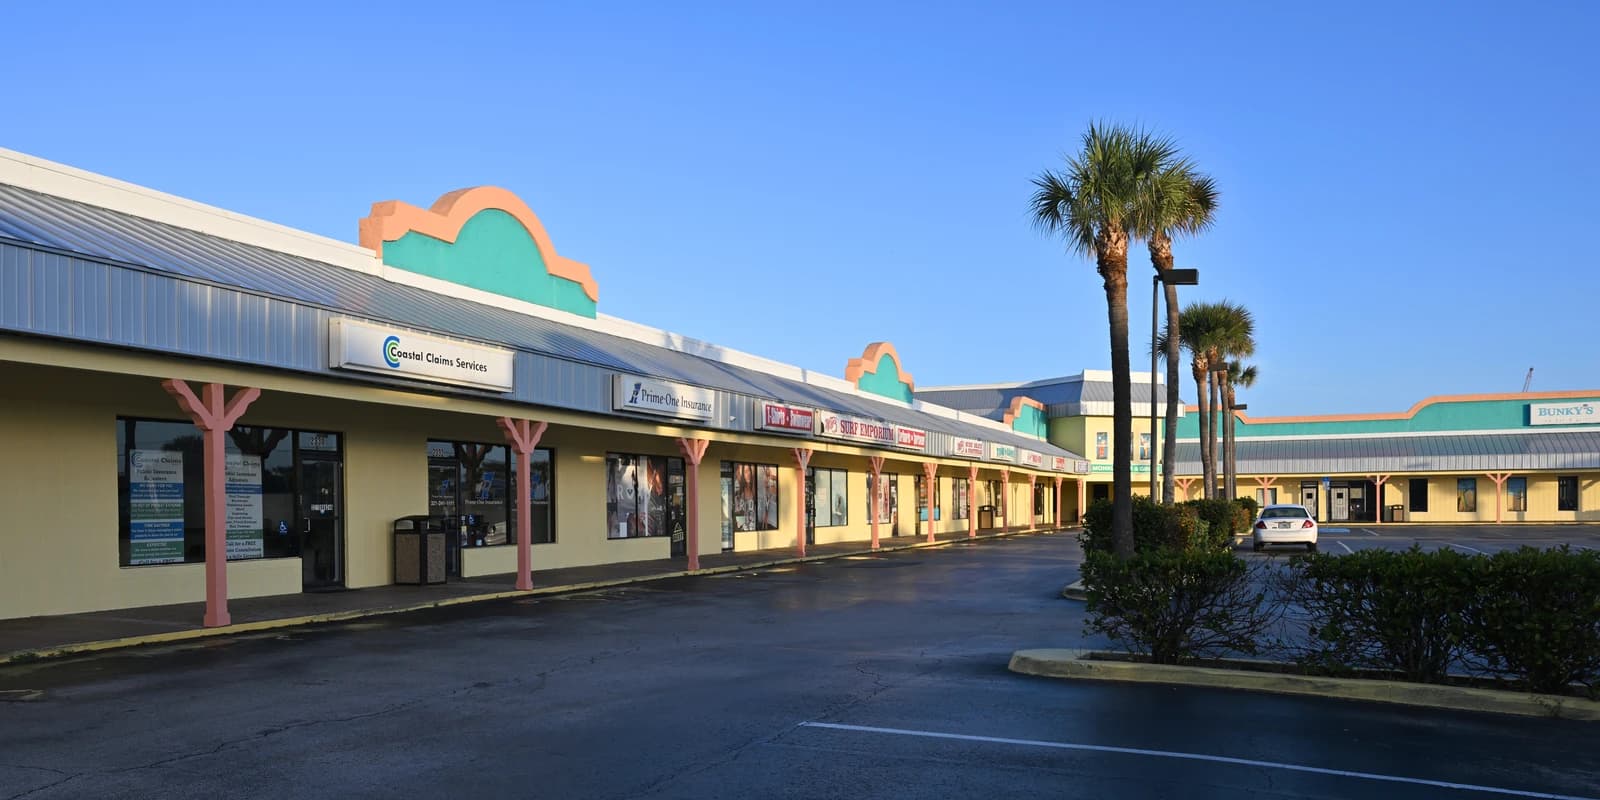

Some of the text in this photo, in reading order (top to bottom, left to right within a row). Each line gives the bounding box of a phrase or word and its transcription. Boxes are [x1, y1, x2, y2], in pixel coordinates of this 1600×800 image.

[390, 346, 488, 373] Coastal Claims Services
[681, 395, 712, 412] Insurance
[1538, 406, 1594, 417] BUNKY'S
[840, 419, 858, 436] SURF
[860, 423, 894, 441] EMPORIUM
